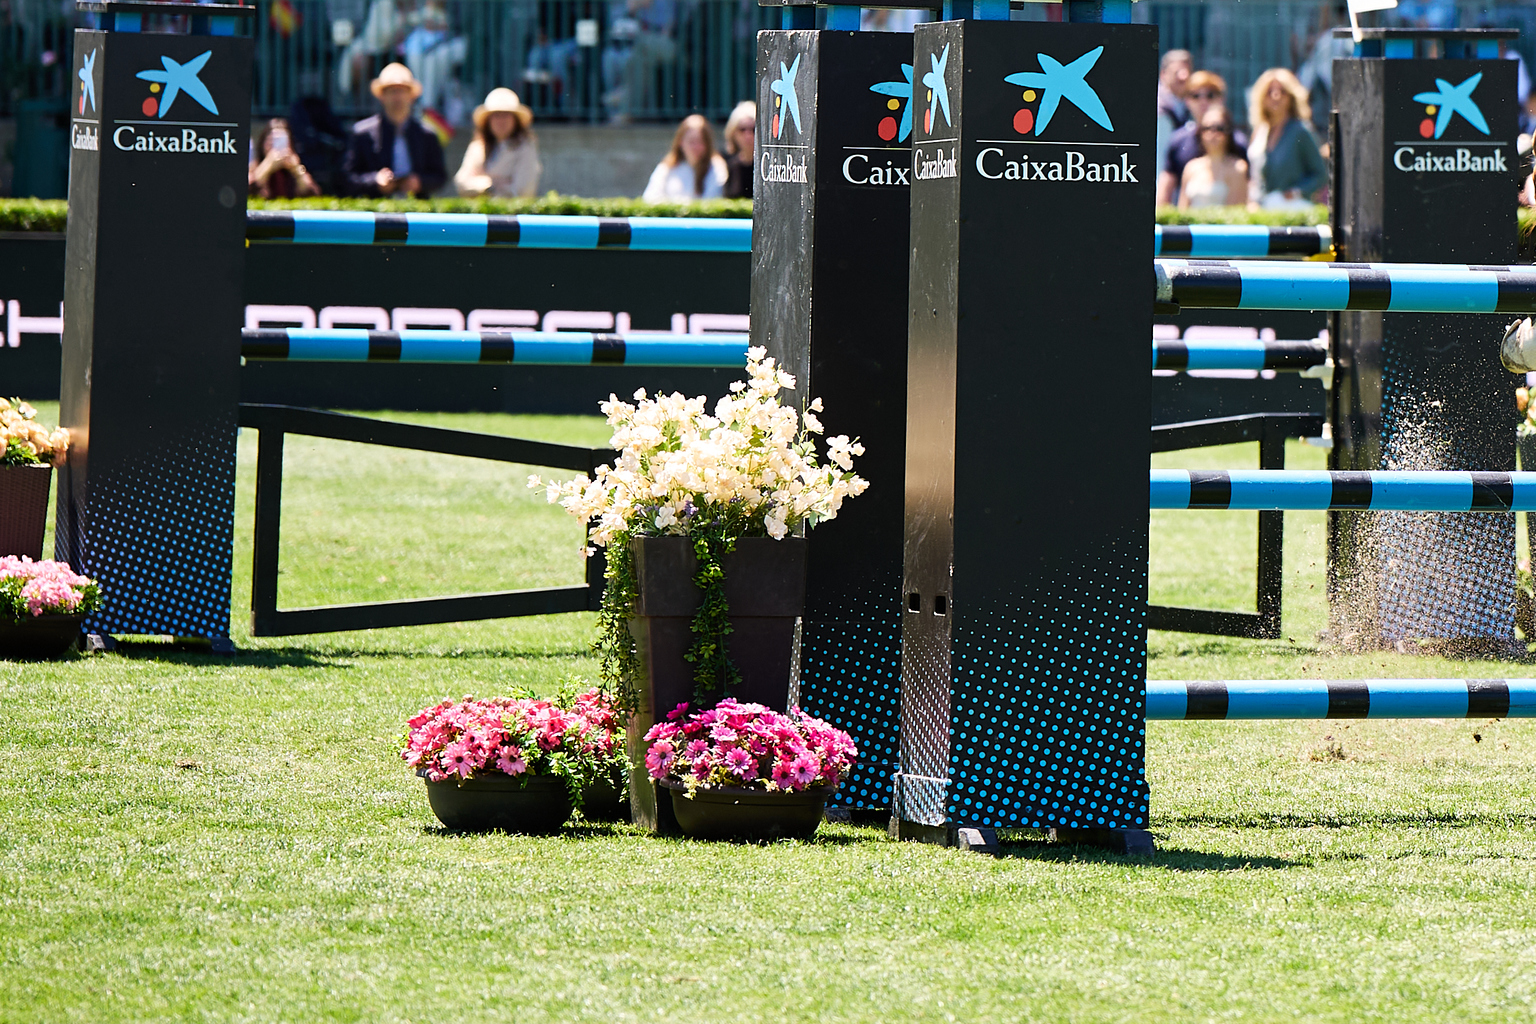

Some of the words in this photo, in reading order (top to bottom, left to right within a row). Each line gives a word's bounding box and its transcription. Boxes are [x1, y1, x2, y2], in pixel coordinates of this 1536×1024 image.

[112, 125, 238, 154] CaixaBank
[760, 151, 808, 184] CaixaBank
[914, 148, 958, 180] CaixaBank
[975, 147, 1140, 183] CaixaBank
[1393, 146, 1508, 173] CaixaBank
